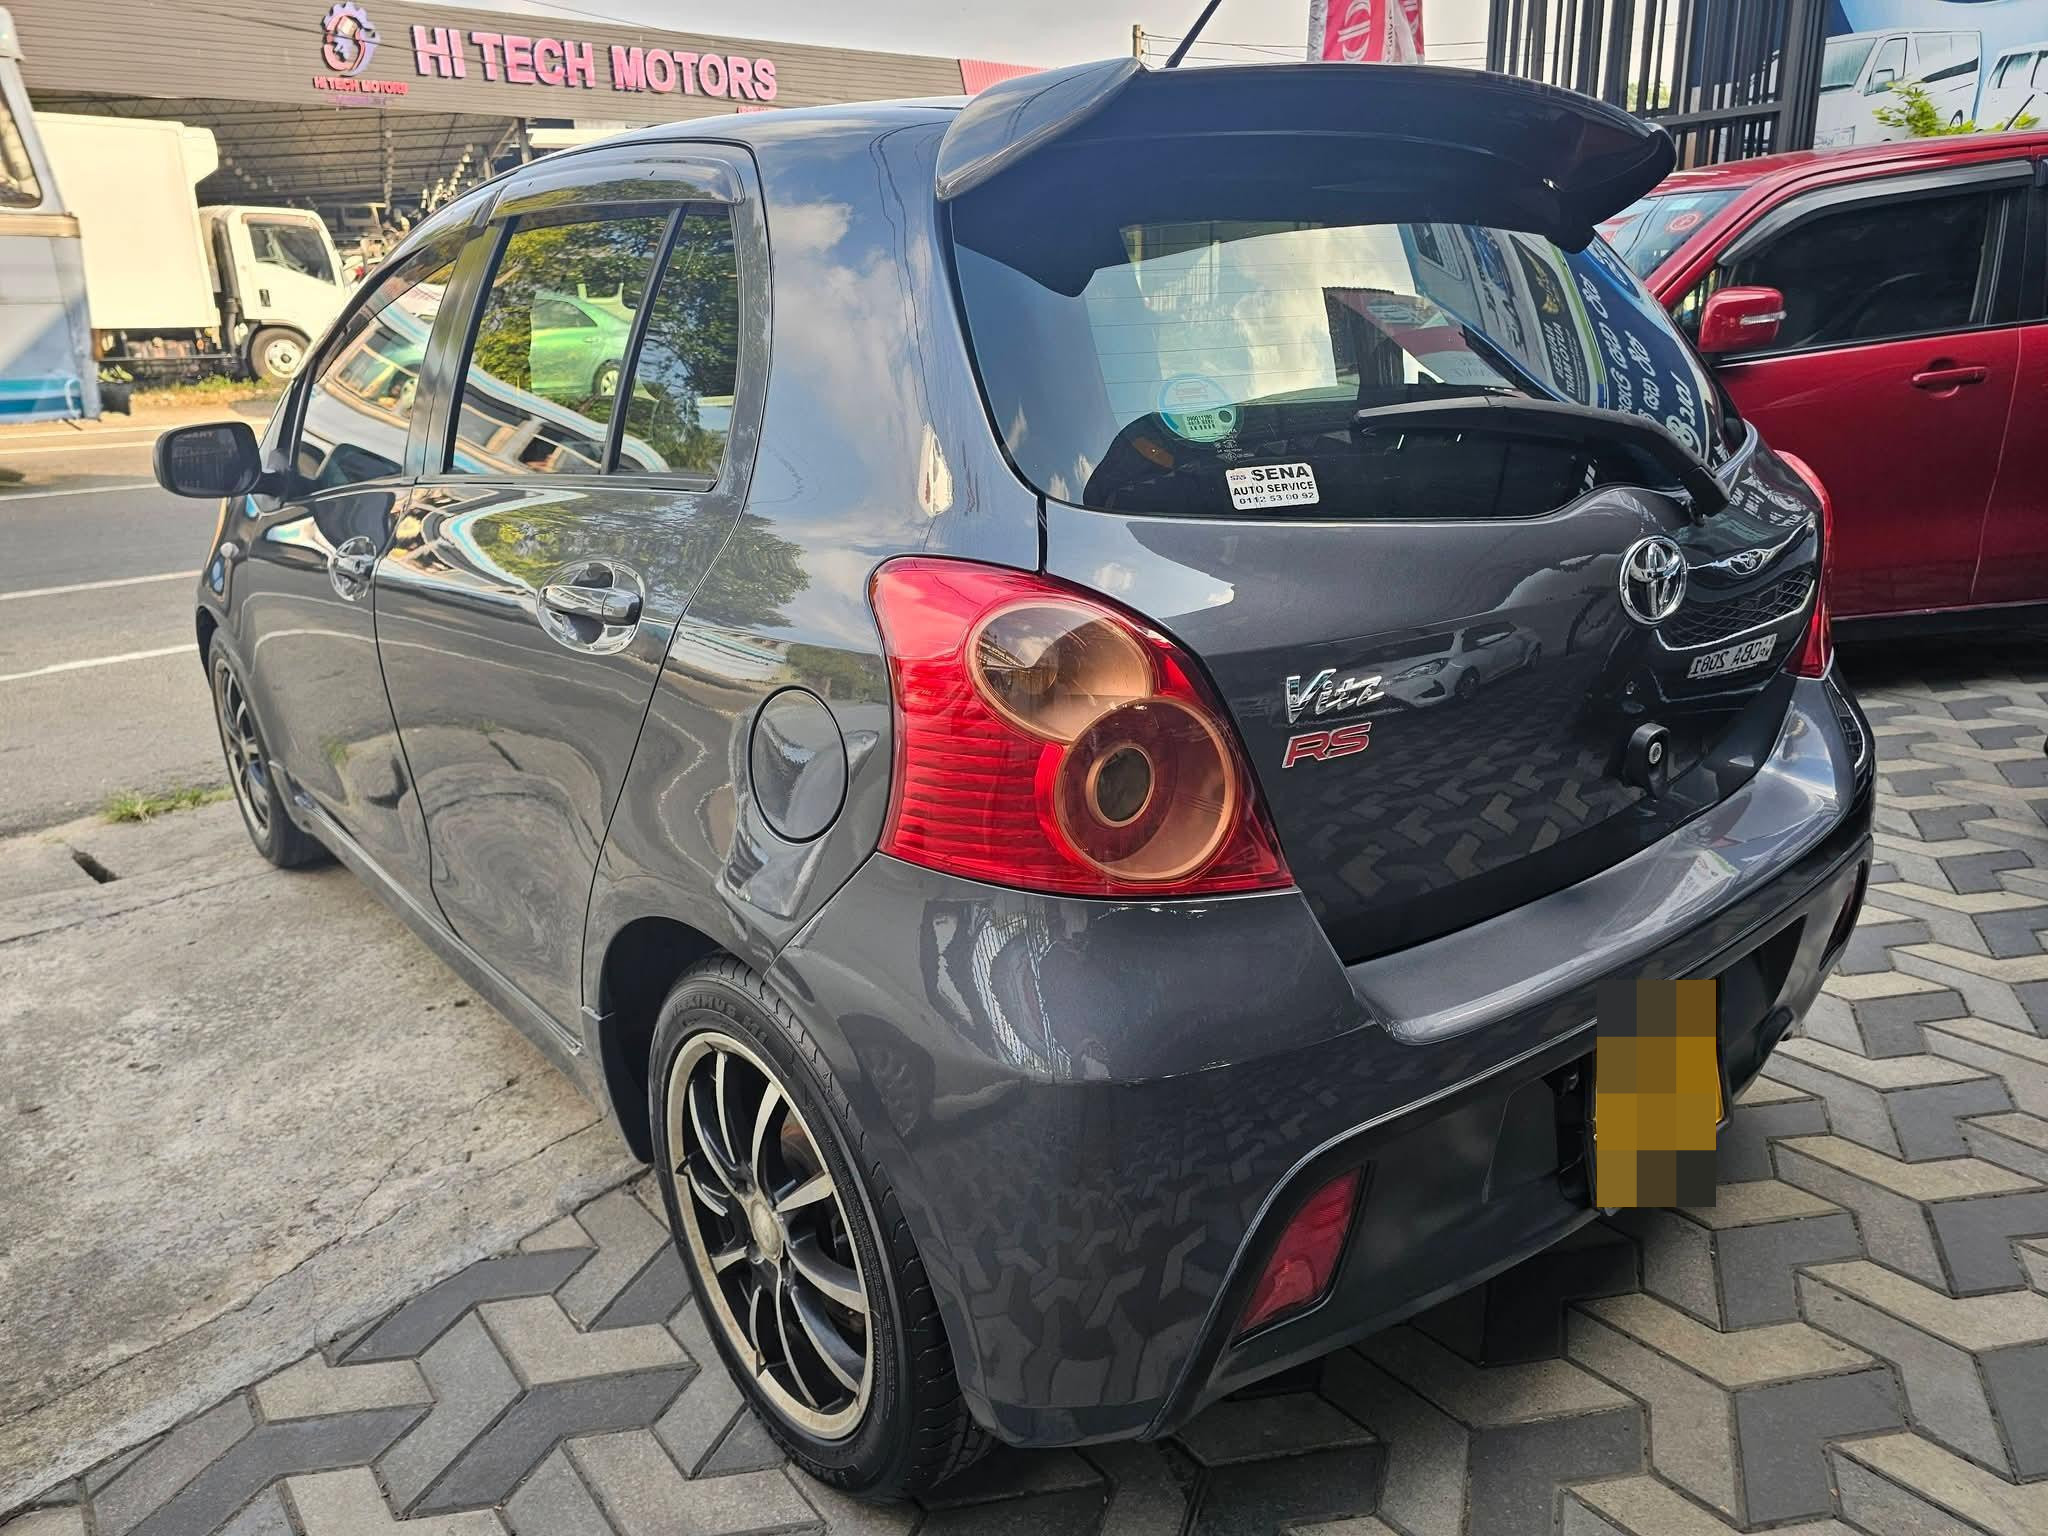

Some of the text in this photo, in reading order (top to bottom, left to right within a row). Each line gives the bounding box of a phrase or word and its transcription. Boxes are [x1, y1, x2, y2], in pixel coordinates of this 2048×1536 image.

[411, 25, 778, 101] HI TECH MOTORS
[1233, 481, 1315, 496] AUTO SERVICE
[1251, 466, 1310, 481] SENA
[1240, 496, 1267, 505] 0112
[1286, 668, 1385, 722] Vitz
[1282, 721, 1372, 769] RS
